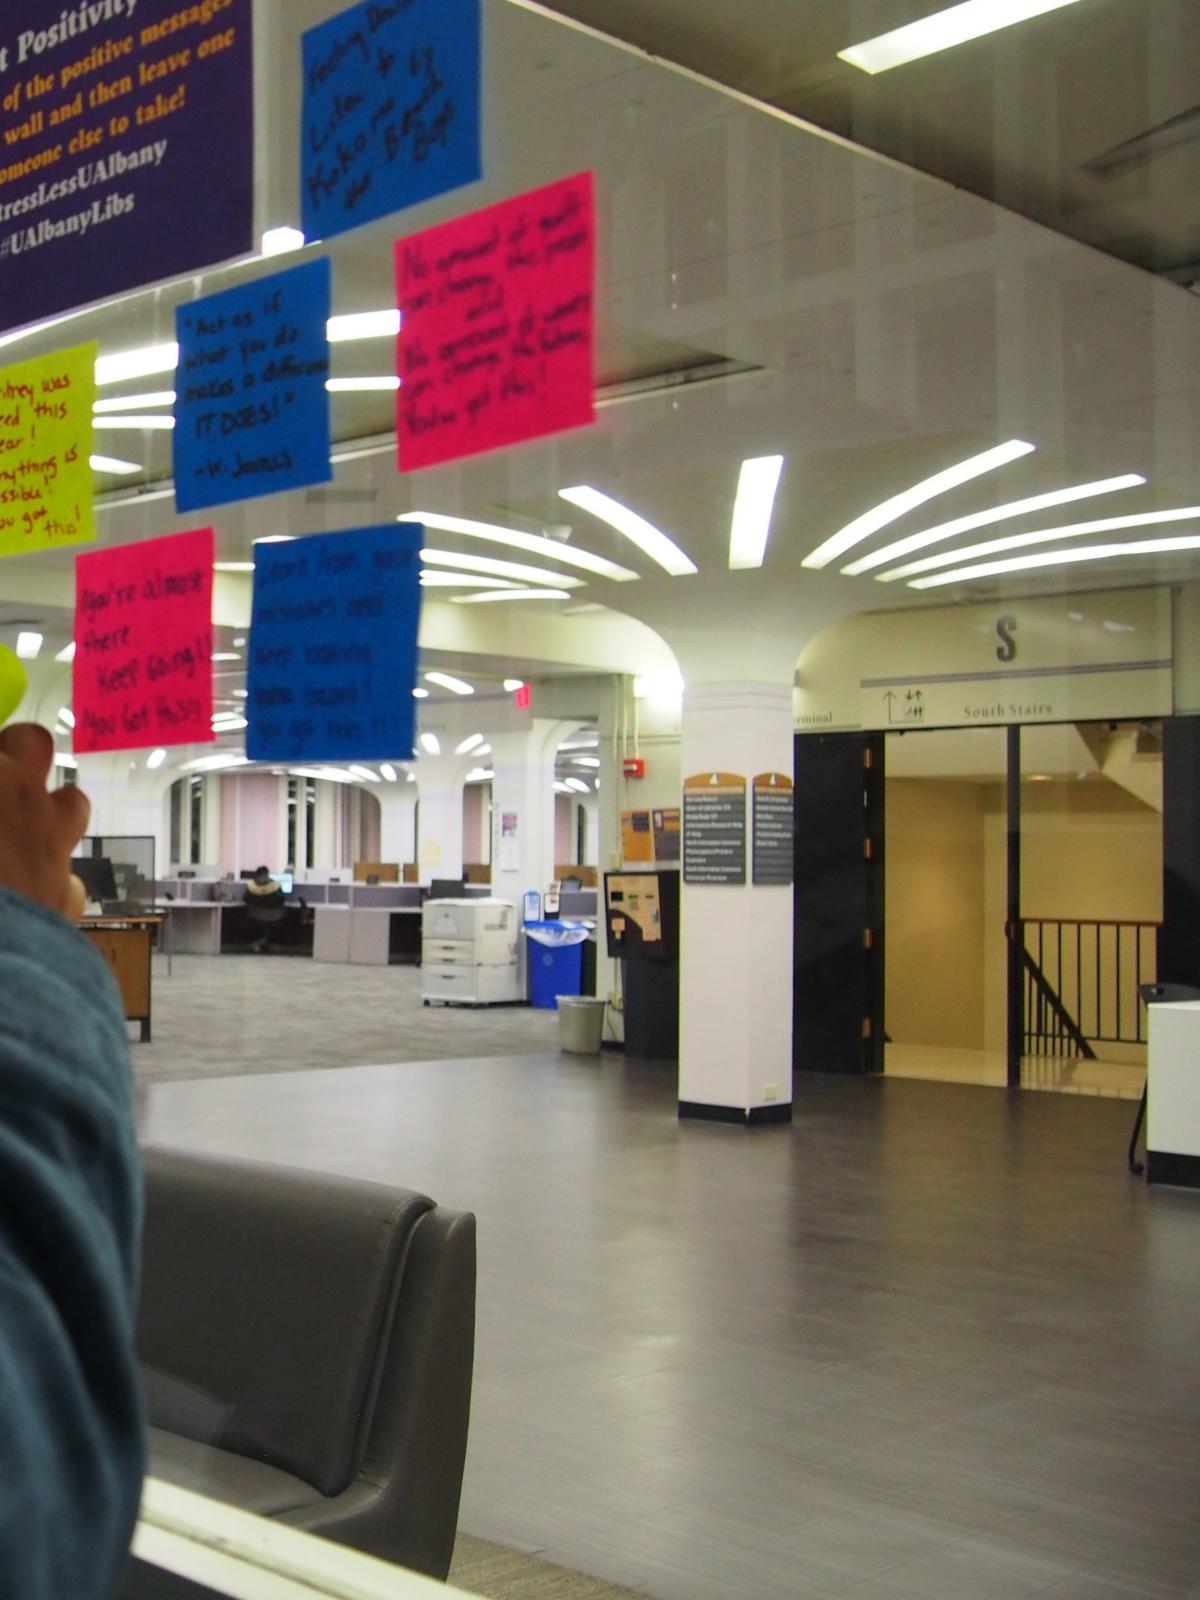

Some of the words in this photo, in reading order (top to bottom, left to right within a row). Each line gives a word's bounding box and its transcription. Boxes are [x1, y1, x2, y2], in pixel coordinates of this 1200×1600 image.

[17, 0, 138, 63] Positivity
[3, 83, 21, 111] of
[26, 73, 55, 99] the
[61, 36, 133, 89] positive
[140, 0, 234, 46] messages
[4, 110, 43, 145] wall
[49, 91, 82, 125] and
[89, 75, 132, 107] then
[139, 48, 190, 85] leave
[197, 27, 235, 58] one
[68, 127, 103, 154] else
[110, 115, 129, 136] to
[136, 84, 186, 125] take!
[0, 193, 135, 259] #UAlbanyLibs
[41, 373, 70, 393] was
[34, 402, 68, 419] this
[65, 443, 79, 464] is
[22, 506, 48, 534] got
[996, 615, 1017, 662] S
[794, 710, 832, 724] rminal
[964, 703, 1005, 718] South
[1009, 701, 1053, 716] Stairs
